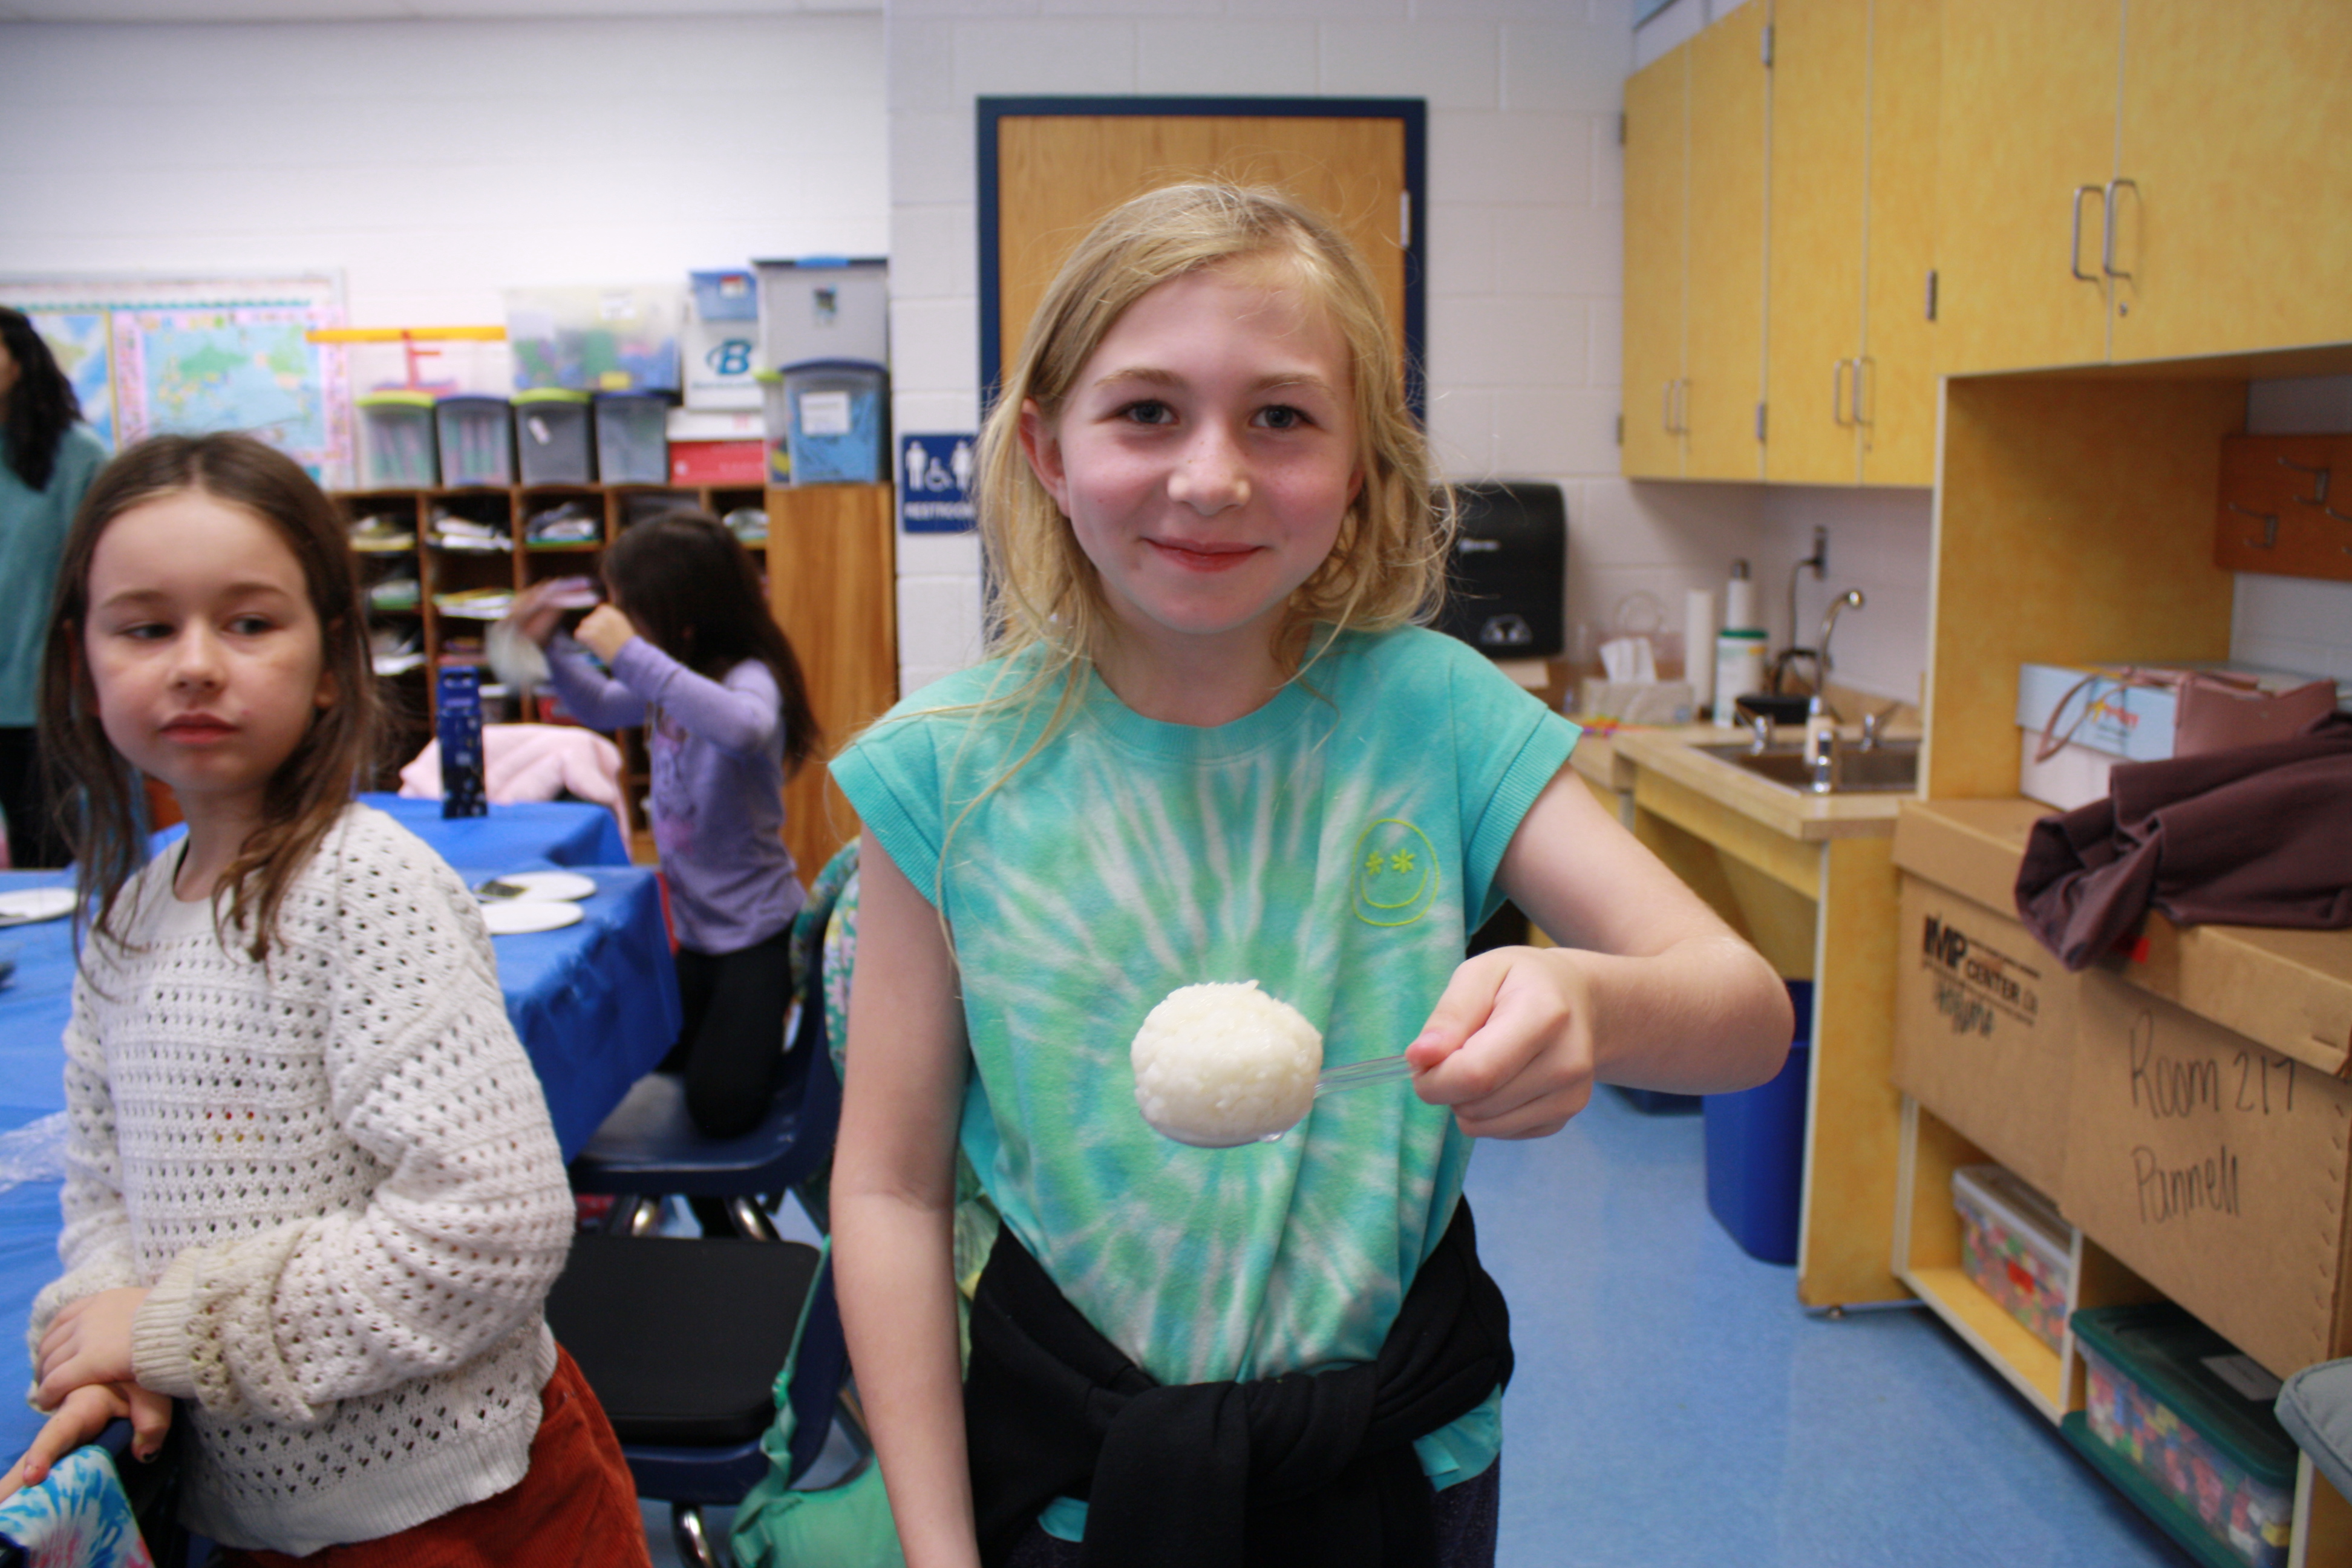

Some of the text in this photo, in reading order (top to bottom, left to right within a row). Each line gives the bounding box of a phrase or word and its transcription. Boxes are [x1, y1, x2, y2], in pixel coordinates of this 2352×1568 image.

[1965, 957, 2020, 1005] CENTER
[2129, 1007, 2296, 1119] Room 217
[2130, 1143, 2241, 1225] Pannell
